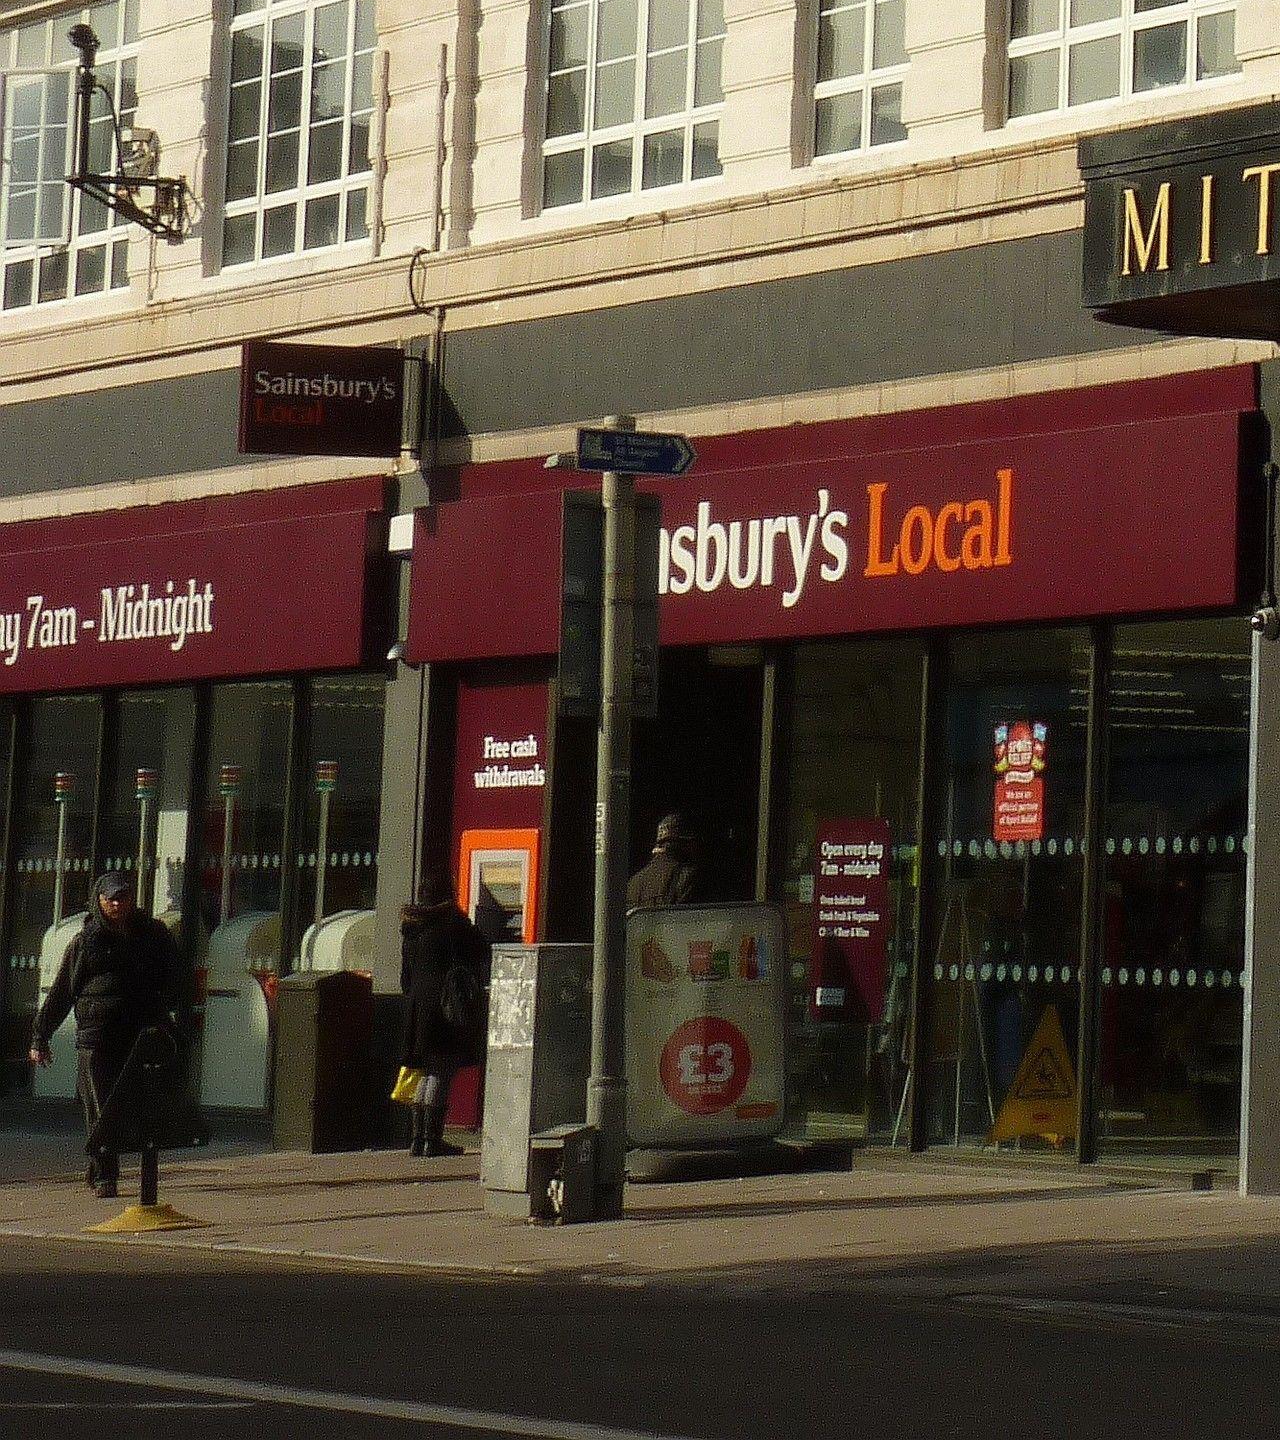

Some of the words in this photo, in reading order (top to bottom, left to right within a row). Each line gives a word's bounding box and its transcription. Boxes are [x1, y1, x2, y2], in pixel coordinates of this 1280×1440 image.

[254, 369, 397, 405] Sainsbury's
[254, 398, 325, 426] Local
[864, 468, 1015, 580] Local
[26, 594, 77, 650] 7am
[82, 618, 96, 630] -
[98, 578, 215, 652] Midnight
[483, 736, 510, 759] Free
[510, 734, 538, 758] cash
[474, 763, 546, 789] withdrawals
[820, 841, 844, 859] Open
[844, 844, 867, 859] every
[867, 841, 884, 859] day
[843, 860, 881, 878] midnight
[676, 1041, 736, 1085] £3
